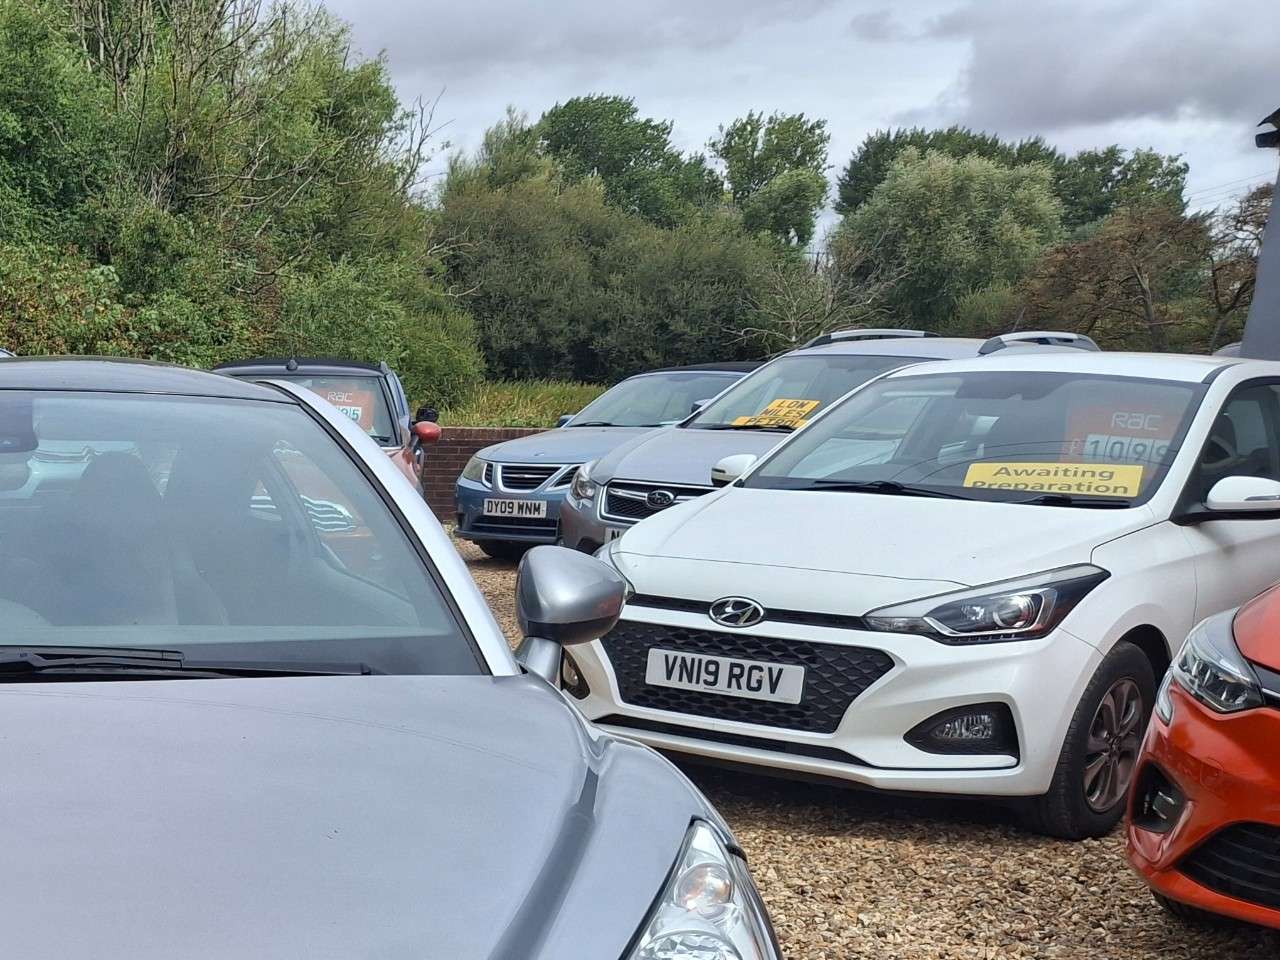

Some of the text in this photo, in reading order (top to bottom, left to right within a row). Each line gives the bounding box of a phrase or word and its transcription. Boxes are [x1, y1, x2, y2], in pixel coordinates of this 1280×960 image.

[992, 466, 1115, 481] Awaiting
[970, 480, 1129, 494] Preparation
[486, 500, 541, 515] DY09 WNM
[664, 654, 784, 695] VN19 RGV
